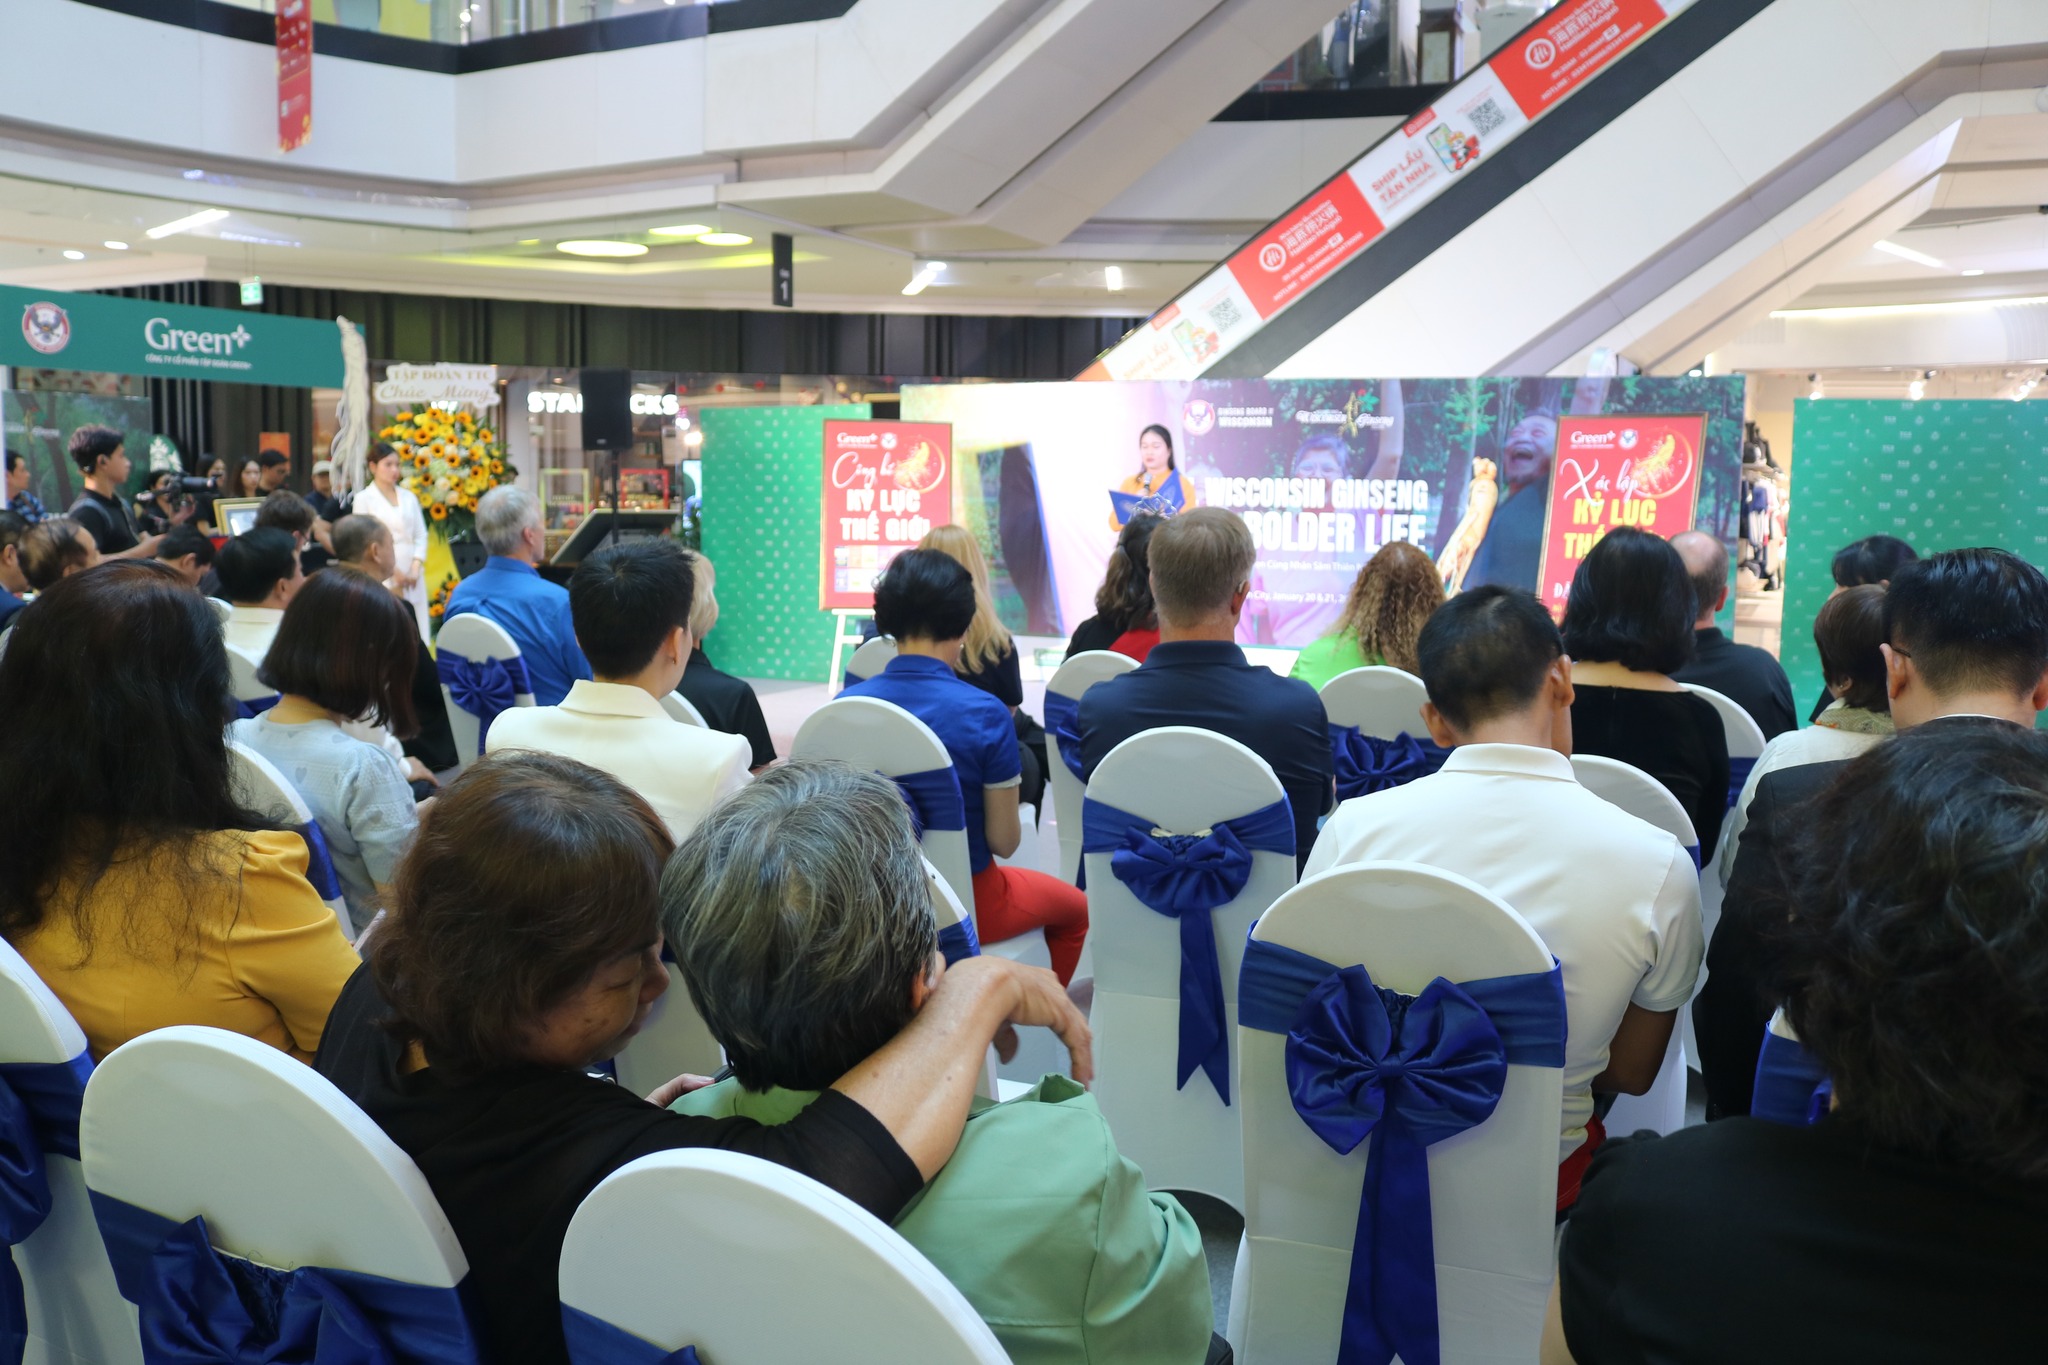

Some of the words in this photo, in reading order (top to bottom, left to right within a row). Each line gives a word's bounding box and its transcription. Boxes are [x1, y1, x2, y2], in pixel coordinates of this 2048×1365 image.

[1371, 168, 1398, 192] SHIP
[780, 280, 789, 301] 1
[394, 369, 419, 382] TẬP
[422, 366, 461, 379] ĐOÀN
[380, 383, 426, 399] Chúc
[432, 384, 490, 402] Mừng
[527, 391, 680, 415] STACKS
[1218, 416, 1273, 428] WISCONSIN
[1246, 407, 1268, 416] BOARD
[1355, 413, 1394, 428] Ginseng
[1560, 458, 1611, 506] Xác
[880, 489, 921, 516] LỤC
[1204, 477, 1326, 508] WISCONSIN
[1331, 479, 1429, 510] GINSENG
[840, 510, 880, 541] THẾ
[885, 515, 931, 541] GIỚI
[1243, 511, 1356, 553] BOLDER
[1364, 514, 1427, 554] LIFE
[1272, 592, 1304, 603] January
[1305, 592, 1316, 602] 20
